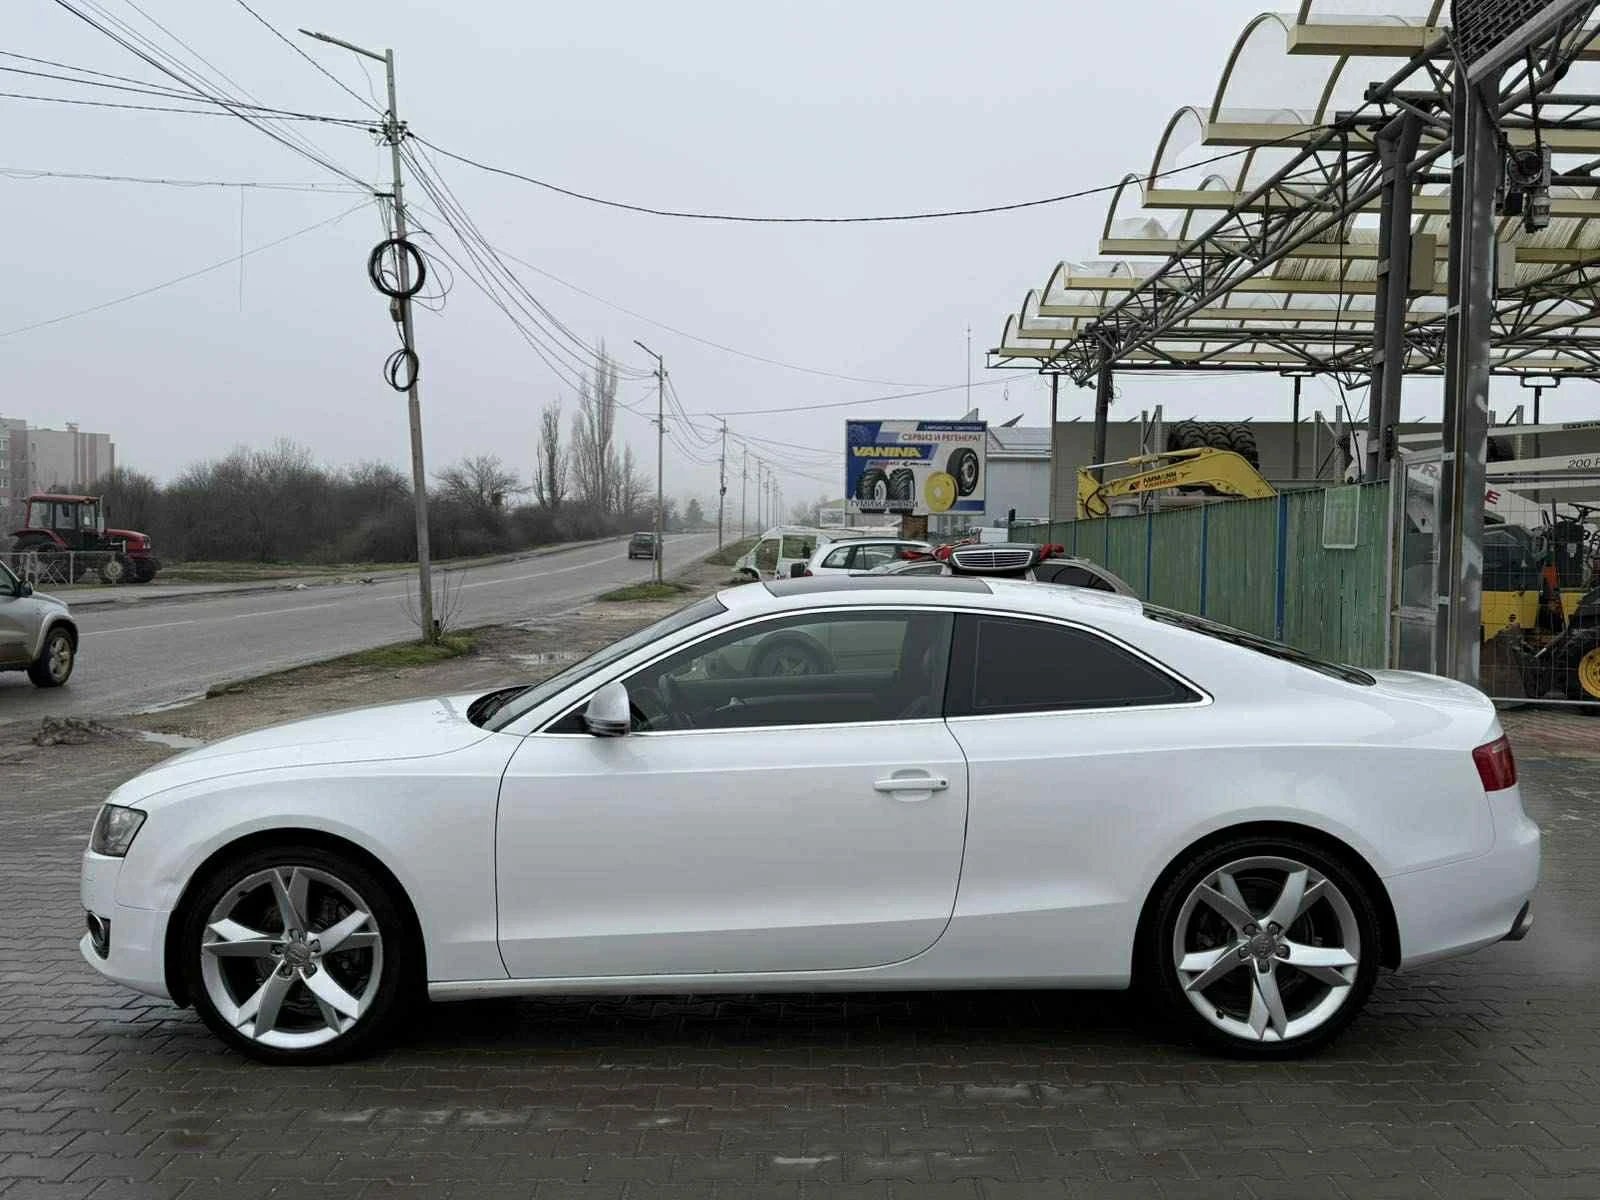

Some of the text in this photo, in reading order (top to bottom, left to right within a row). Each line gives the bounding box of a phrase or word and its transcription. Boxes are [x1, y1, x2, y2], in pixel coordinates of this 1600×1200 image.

[902, 433, 932, 441] СЕРВИЗ
[942, 433, 982, 442] РЕГЕНЕРАТ
[852, 446, 921, 458] VANINA
[1568, 457, 1591, 468] 200
